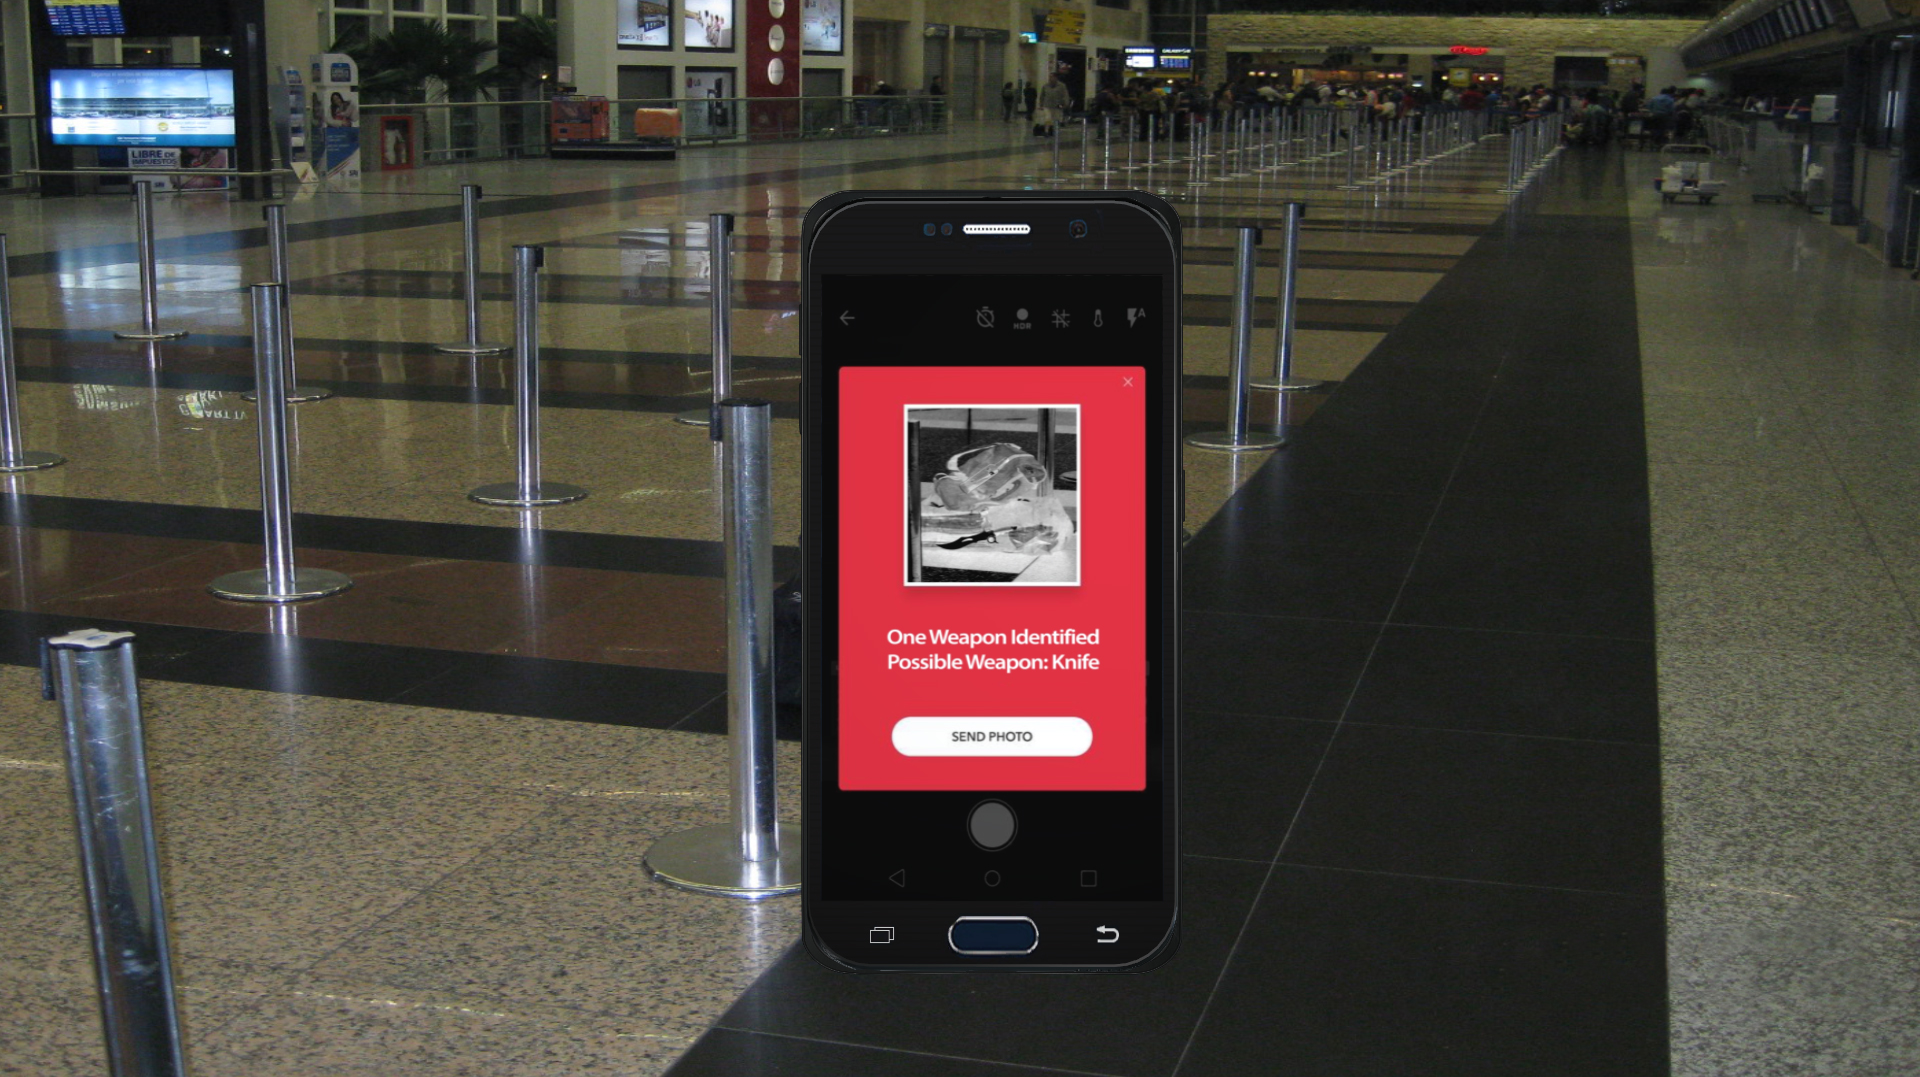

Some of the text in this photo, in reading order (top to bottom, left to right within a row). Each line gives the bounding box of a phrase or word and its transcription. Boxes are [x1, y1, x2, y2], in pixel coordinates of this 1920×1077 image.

[132, 150, 162, 158] LIBRE
[1013, 322, 1032, 330] HDR
[887, 628, 1100, 648] One Weapon Identified
[888, 653, 1100, 673] Possible Weapon: Knife
[952, 731, 1033, 742] SEND PHOTO
